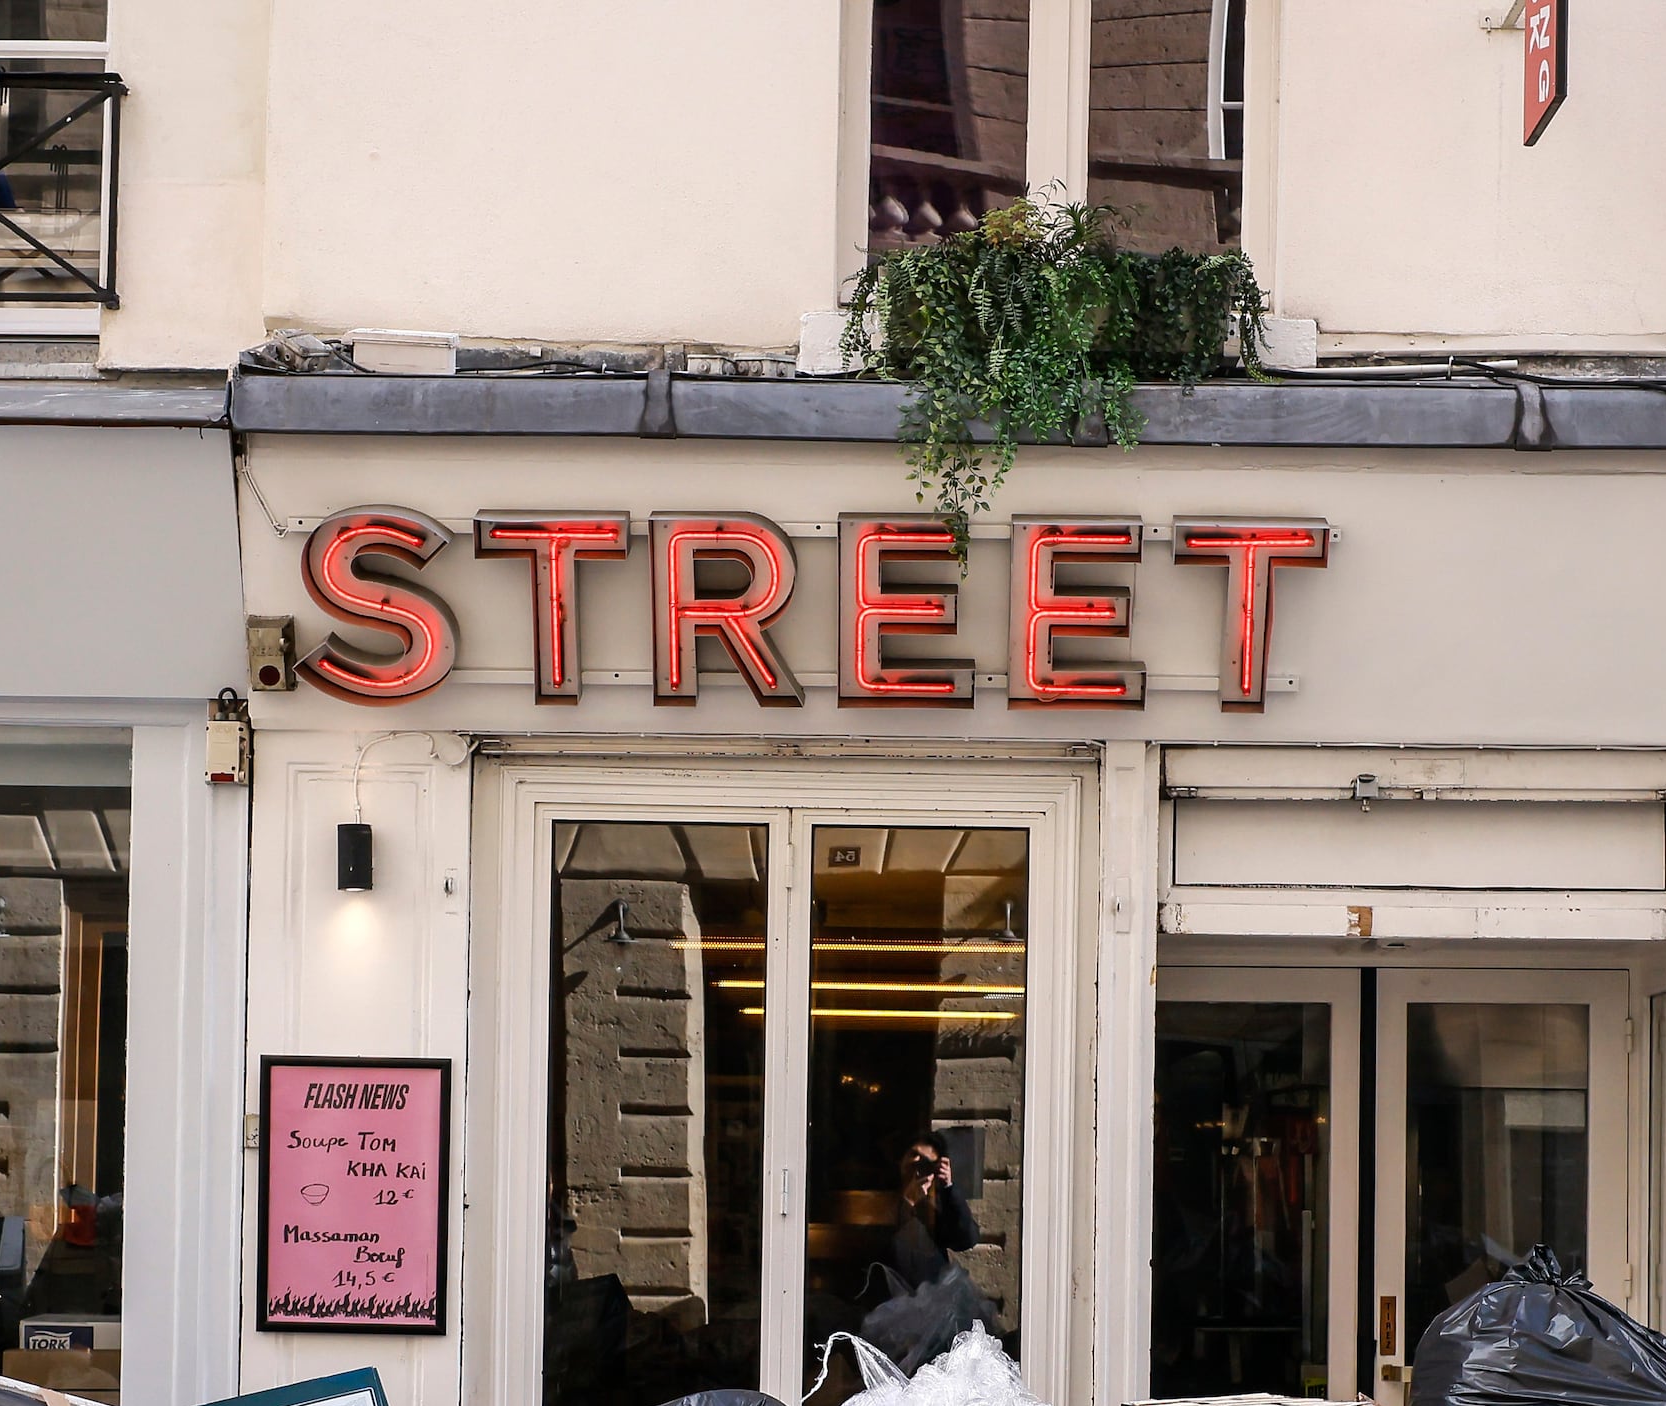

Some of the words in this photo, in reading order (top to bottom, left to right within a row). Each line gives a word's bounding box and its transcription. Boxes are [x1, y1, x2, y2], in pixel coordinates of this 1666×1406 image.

[294, 505, 1331, 714] STREET
[304, 1083, 358, 1109] FLASH
[361, 1084, 410, 1110] NEWS
[287, 1130, 349, 1153] Soupe
[347, 1161, 388, 1177] KHA
[284, 1224, 380, 1244] Massaman
[31, 1339, 69, 1350] TORK
